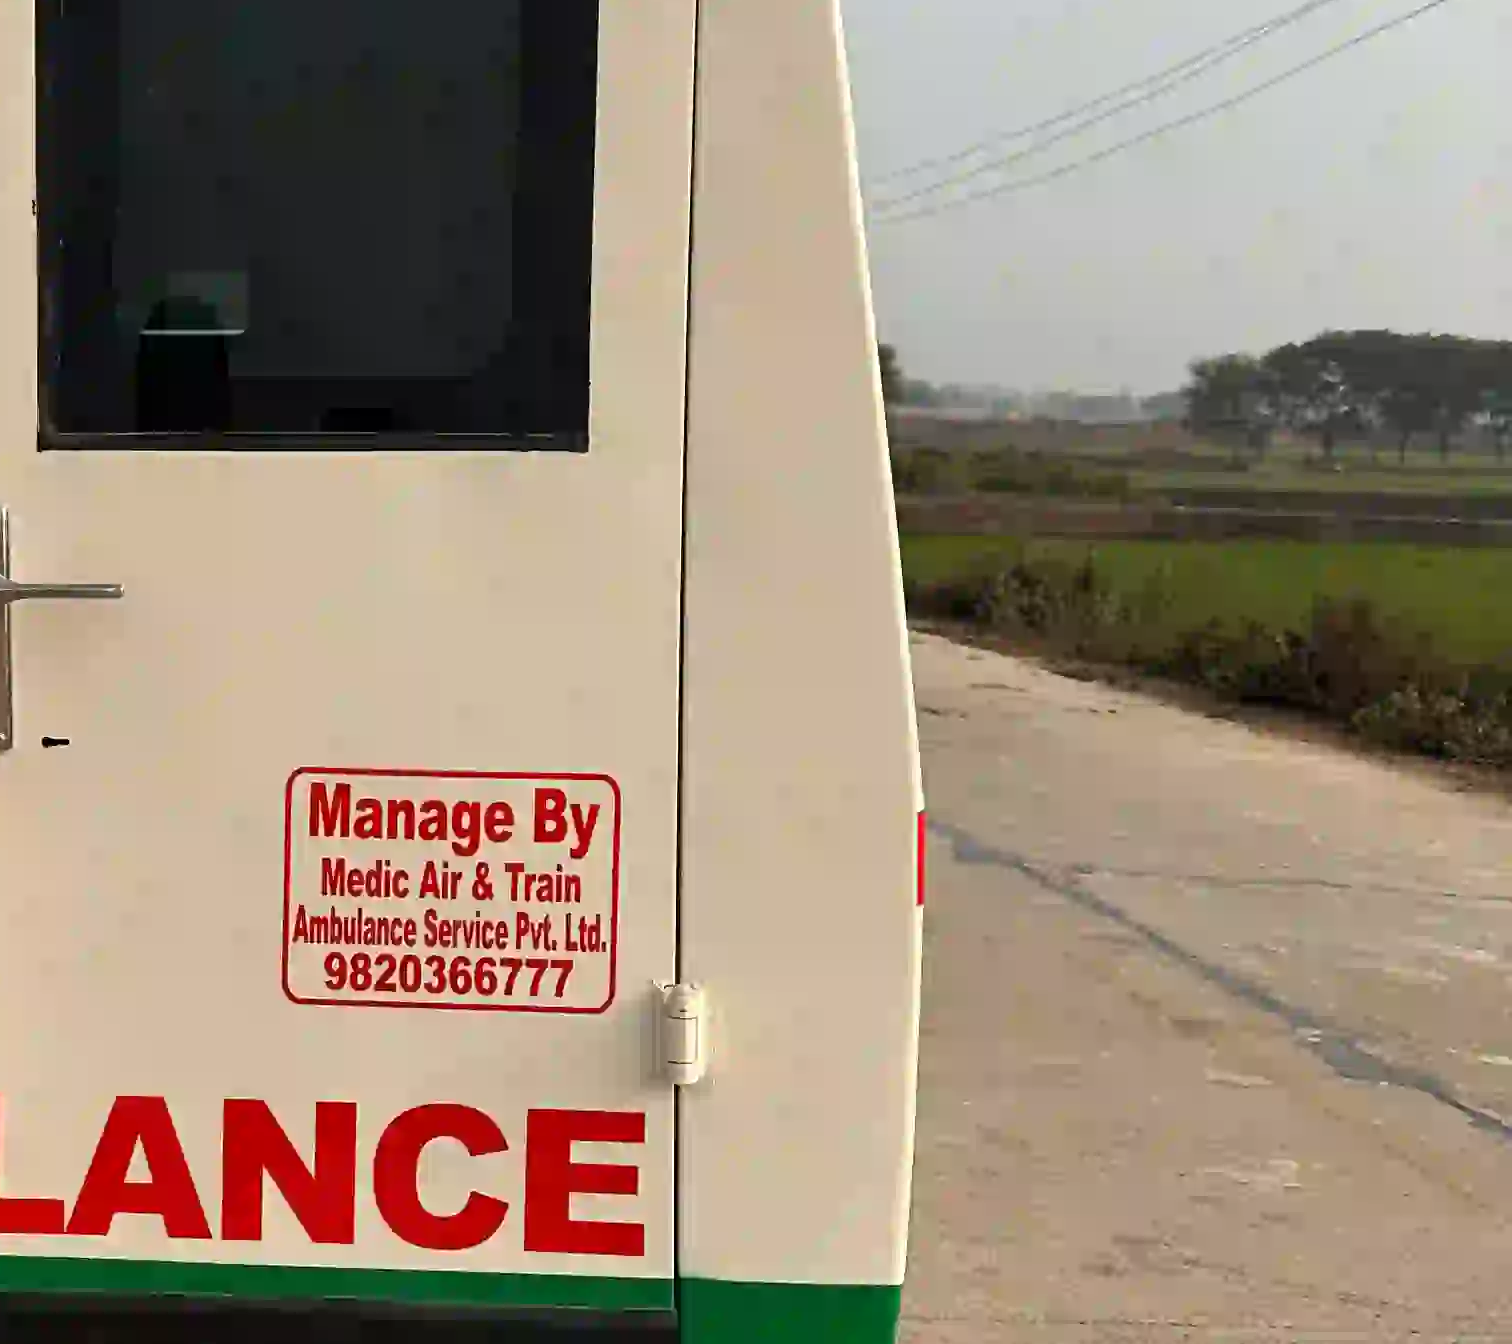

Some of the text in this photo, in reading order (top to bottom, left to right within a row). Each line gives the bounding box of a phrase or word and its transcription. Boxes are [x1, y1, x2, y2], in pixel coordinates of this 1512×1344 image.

[309, 782, 601, 859] Manage By
[321, 857, 581, 903] Medic Air & Train
[292, 904, 607, 953] Ambulance Service Pvt. Ltd.
[323, 951, 574, 999] 9820366777
